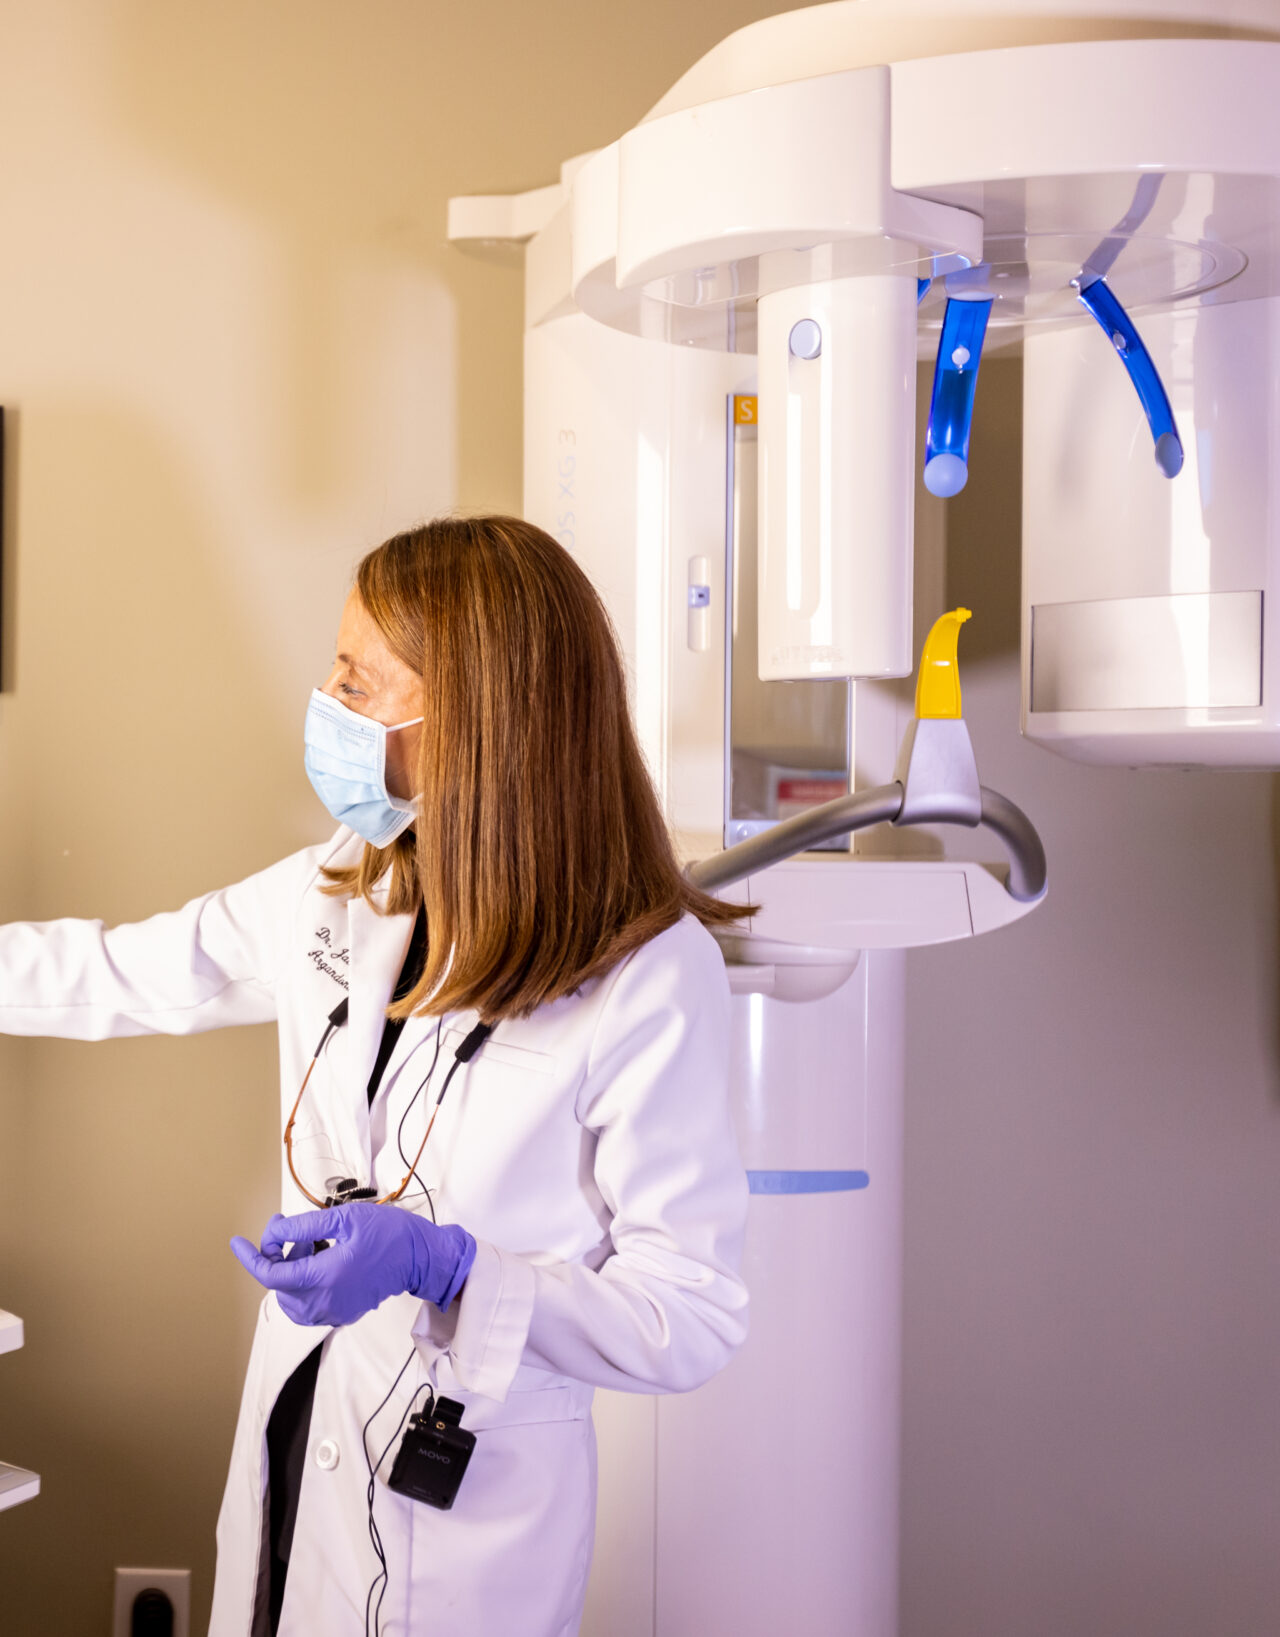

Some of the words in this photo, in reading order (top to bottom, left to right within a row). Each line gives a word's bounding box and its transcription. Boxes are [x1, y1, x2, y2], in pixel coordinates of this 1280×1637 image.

[558, 429, 577, 447] 3
[558, 455, 577, 499] XG
[558, 510, 576, 552] OS
[315, 926, 332, 948] Dr.
[330, 948, 350, 966] Ja
[307, 950, 350, 991] Argandon
[418, 1448, 450, 1464] MOVO
